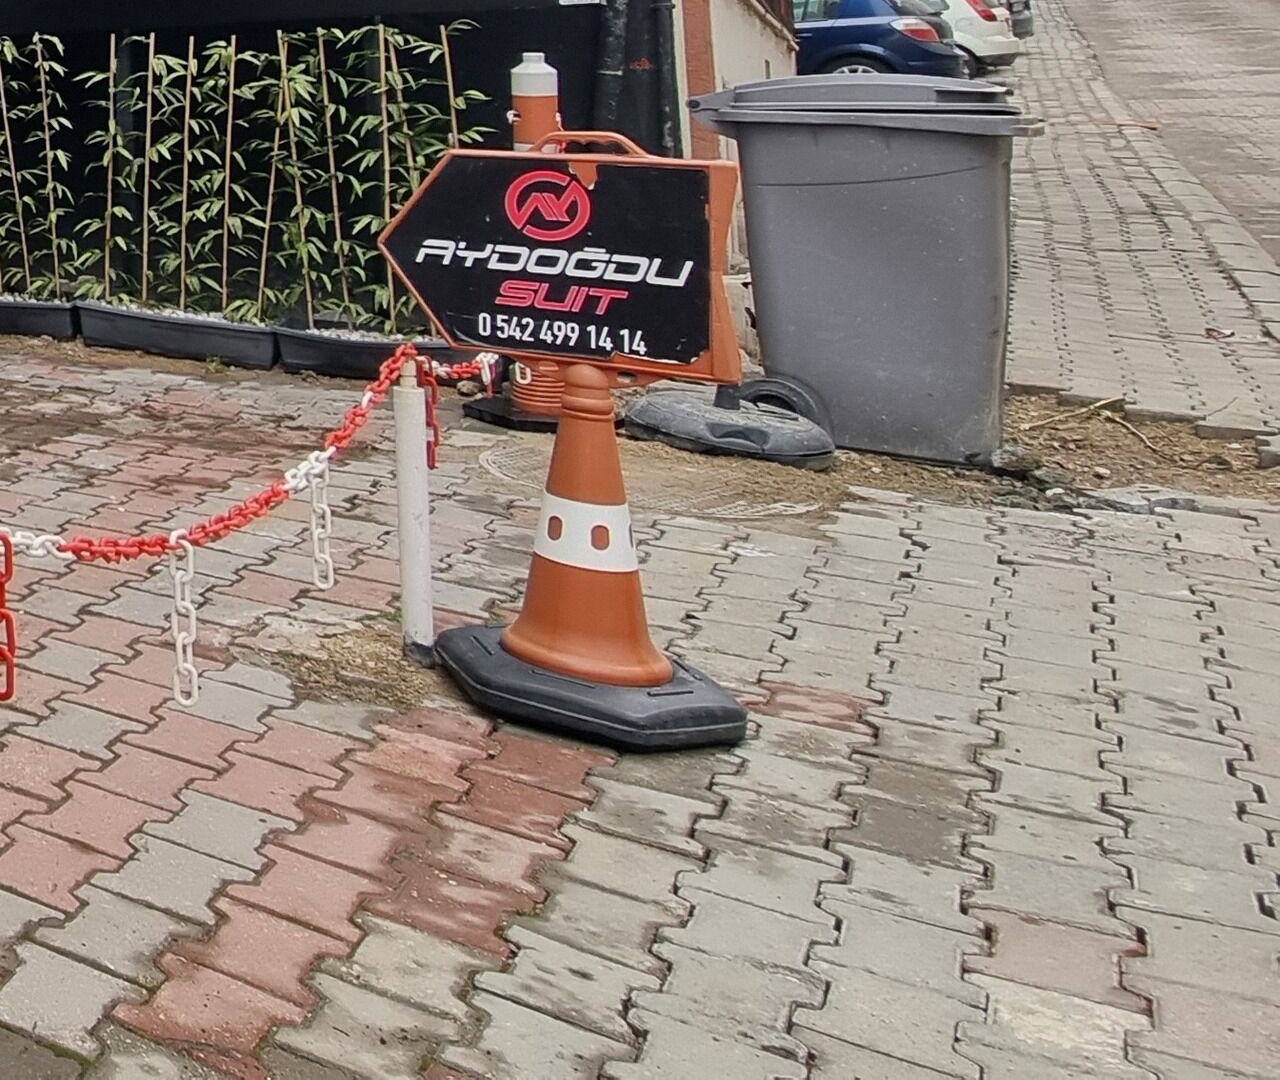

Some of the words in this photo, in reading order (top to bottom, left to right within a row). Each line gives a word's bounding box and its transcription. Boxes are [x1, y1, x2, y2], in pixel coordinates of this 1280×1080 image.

[415, 239, 694, 287] AYDOĞDU
[495, 279, 629, 315] SUIT
[478, 312, 490, 337] 0
[496, 315, 534, 342] 542
[539, 319, 580, 347] 499
[586, 325, 613, 351] 14
[620, 329, 647, 356] 14
